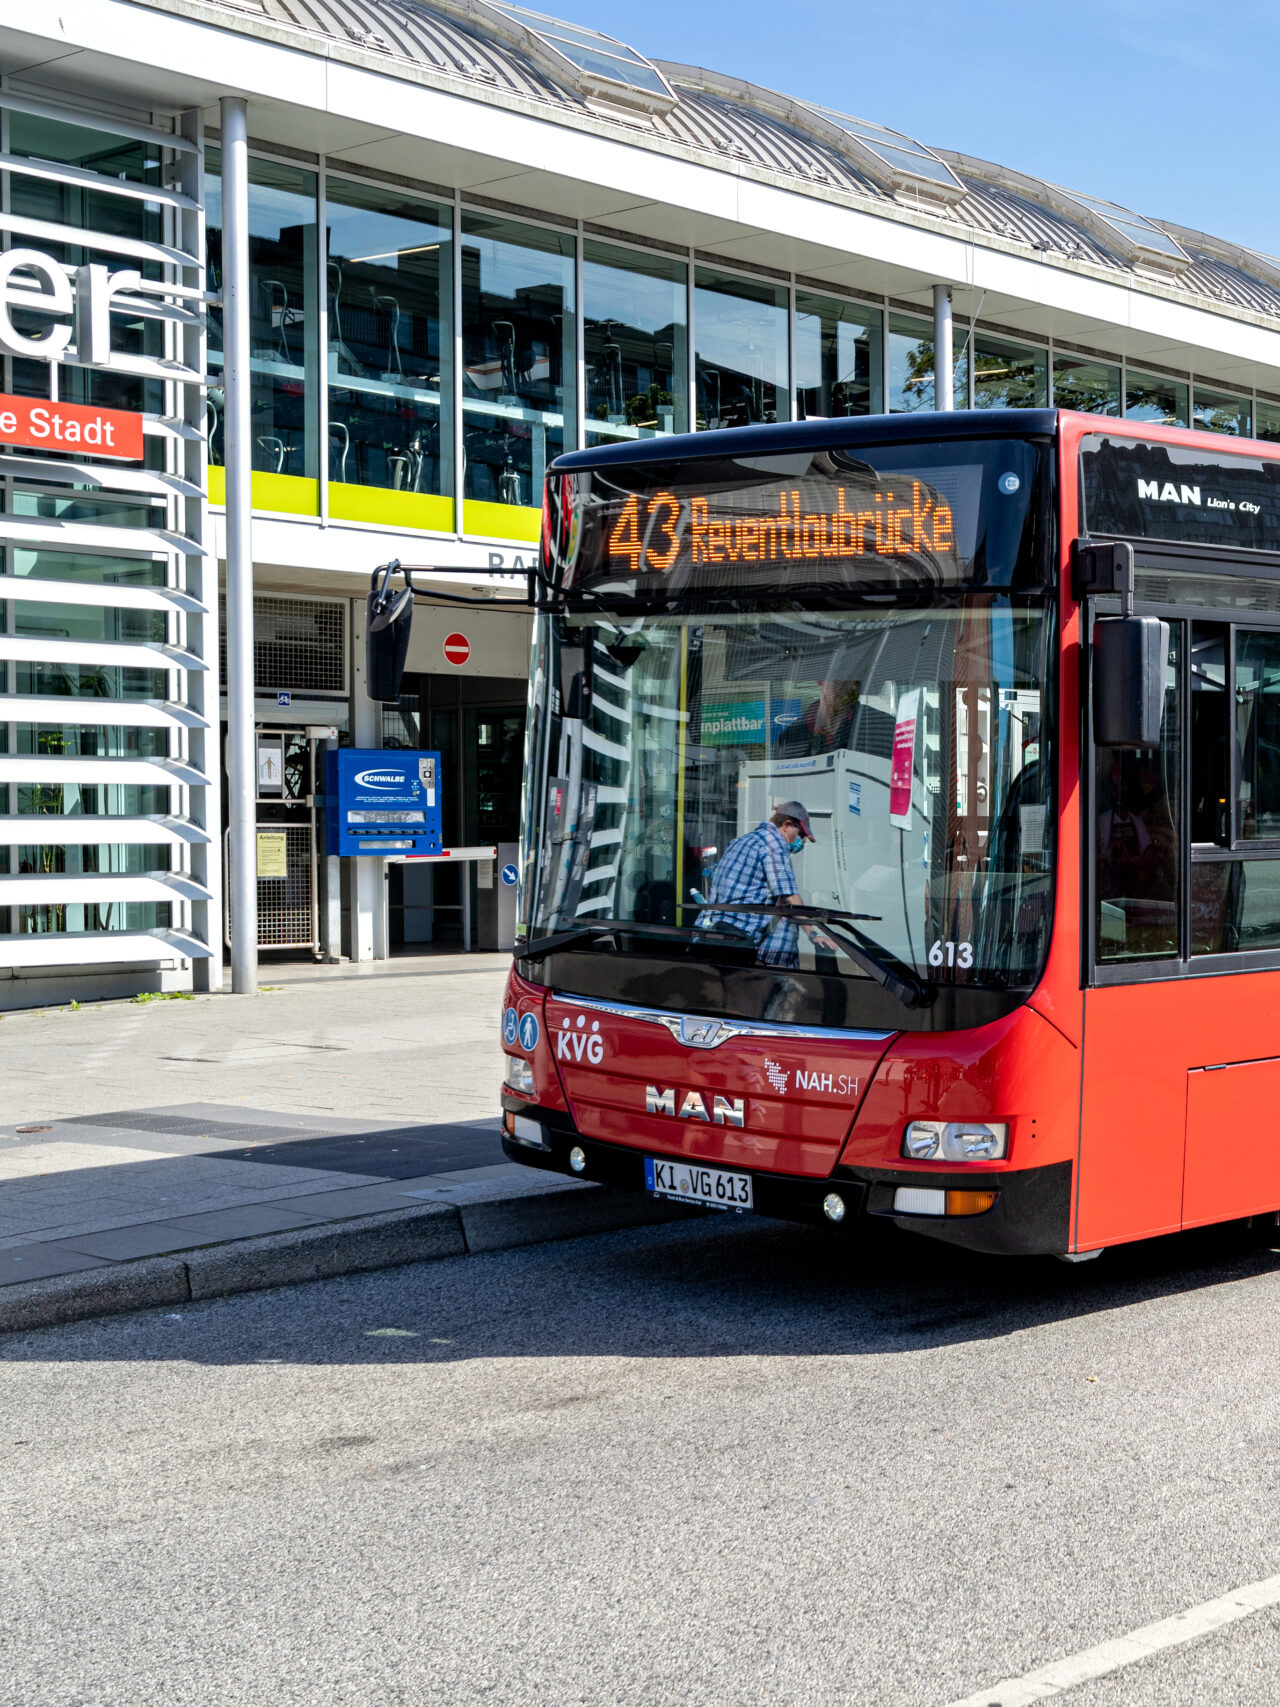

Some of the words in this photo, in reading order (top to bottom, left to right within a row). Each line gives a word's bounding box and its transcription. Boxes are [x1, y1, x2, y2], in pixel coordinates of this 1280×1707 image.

[30, 408, 115, 447] Stadt
[1137, 478, 1201, 505] MAN
[1206, 497, 1236, 510] Lion's
[1239, 500, 1261, 514] City
[609, 492, 680, 569] 43
[691, 481, 952, 563] Reventloubrücke
[363, 774, 405, 782] SCHWALBE
[928, 940, 973, 969] 613
[557, 1030, 603, 1064] KVG
[795, 1070, 859, 1096] NAH.SH
[646, 1085, 745, 1127] MAN
[655, 1163, 677, 1190] KI
